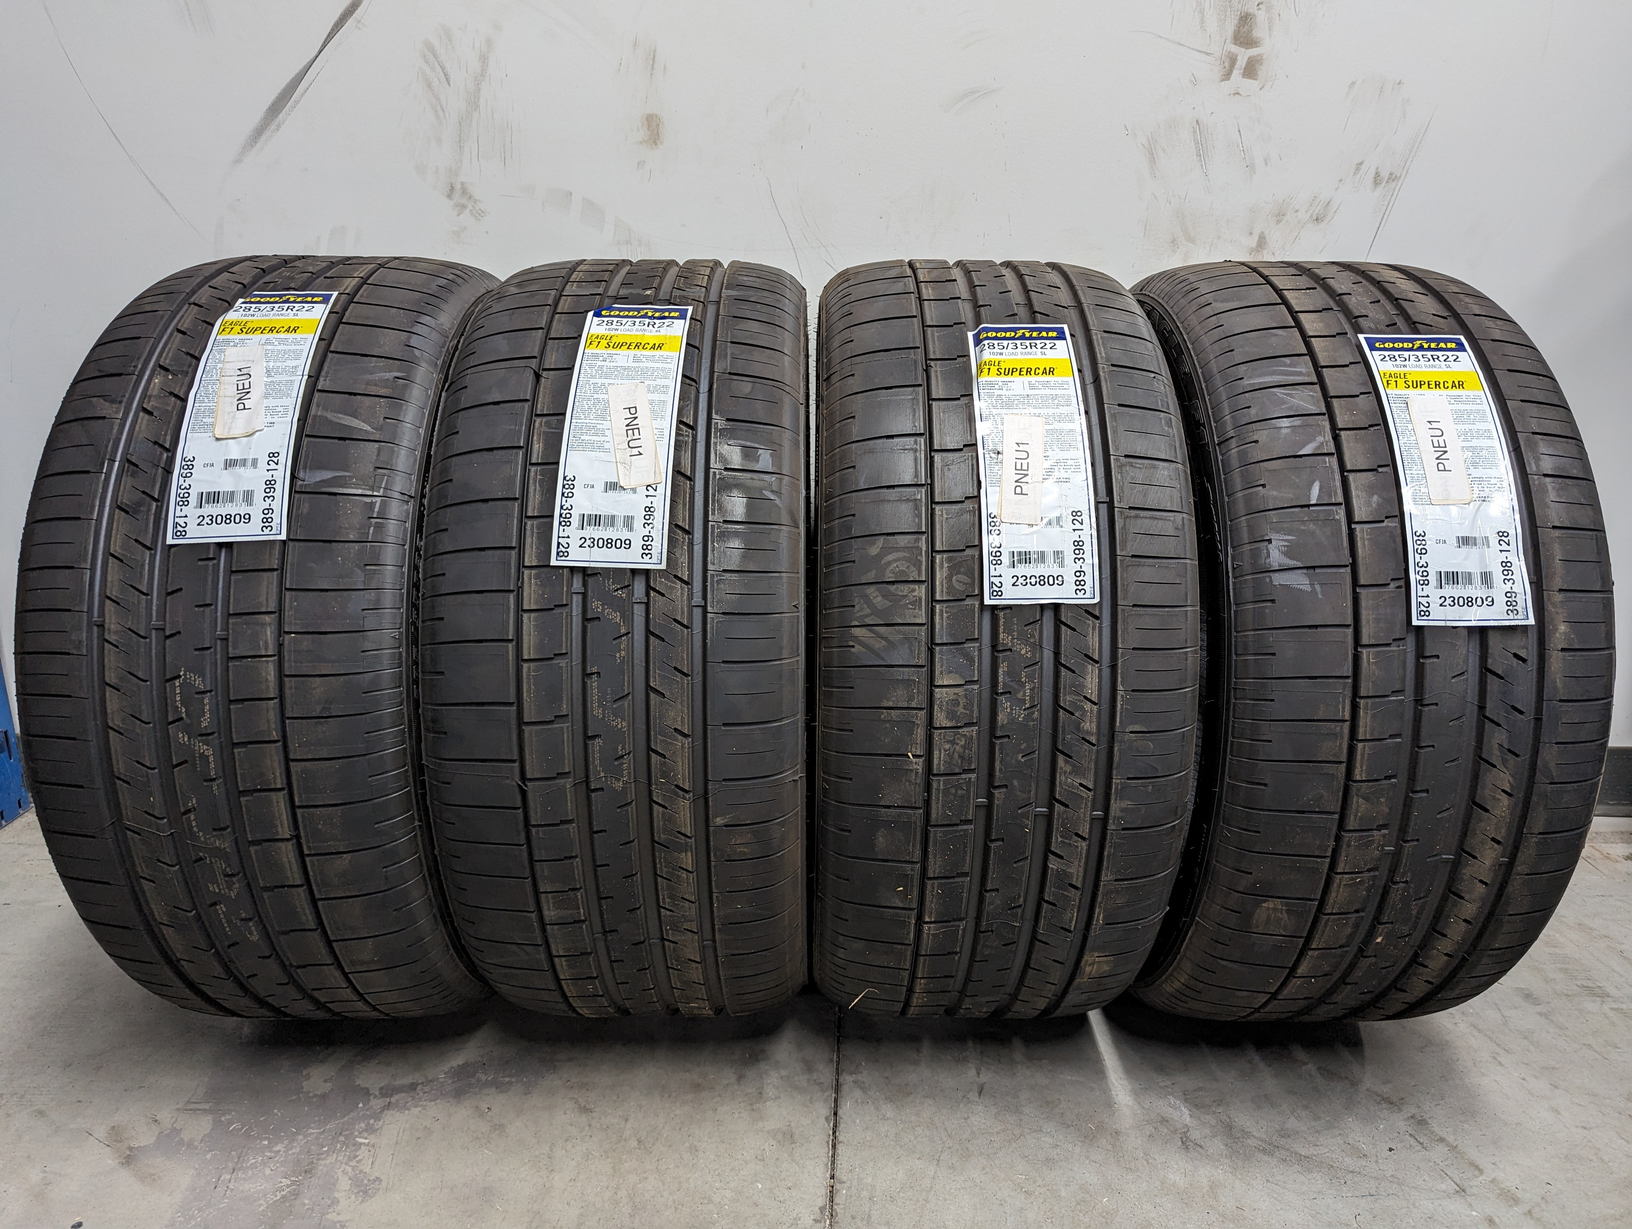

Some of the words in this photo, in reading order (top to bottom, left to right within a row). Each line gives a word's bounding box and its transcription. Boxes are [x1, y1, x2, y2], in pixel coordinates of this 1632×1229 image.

[601, 309, 680, 317] GOODYEAR
[596, 319, 674, 328] 285/35R22
[219, 327, 234, 335] F1
[237, 326, 300, 335] SUPERCAR
[979, 330, 1058, 339] GOODYEAR
[587, 341, 601, 349] F1
[604, 341, 665, 351] SUPERCAR
[980, 342, 1058, 354] 285/35R22
[1375, 341, 1458, 349] GOODYEAR
[1378, 354, 1462, 363] 285/35R22
[979, 367, 991, 377] F1
[996, 367, 1055, 376] SUPERCAR
[236, 366, 252, 411] PNEU1
[1386, 380, 1398, 388] F1
[1404, 380, 1465, 389] SUPERCAR
[623, 406, 644, 457] PNEU1
[1426, 420, 1452, 473] PNEU1
[1014, 442, 1030, 496] PNEU1
[174, 456, 195, 537] 389-398-128
[261, 451, 280, 533] 389-398-128
[196, 512, 251, 526] 230809
[557, 475, 576, 558] 389-398-128
[641, 484, 658, 560] 389-398-12
[578, 537, 632, 549] 230809
[1071, 510, 1086, 596] 389-398-128
[1414, 530, 1430, 618] 389-398-128
[1497, 530, 1519, 616] 389-398-128
[1011, 574, 1065, 587] 230809
[1438, 596, 1495, 607] 230809
